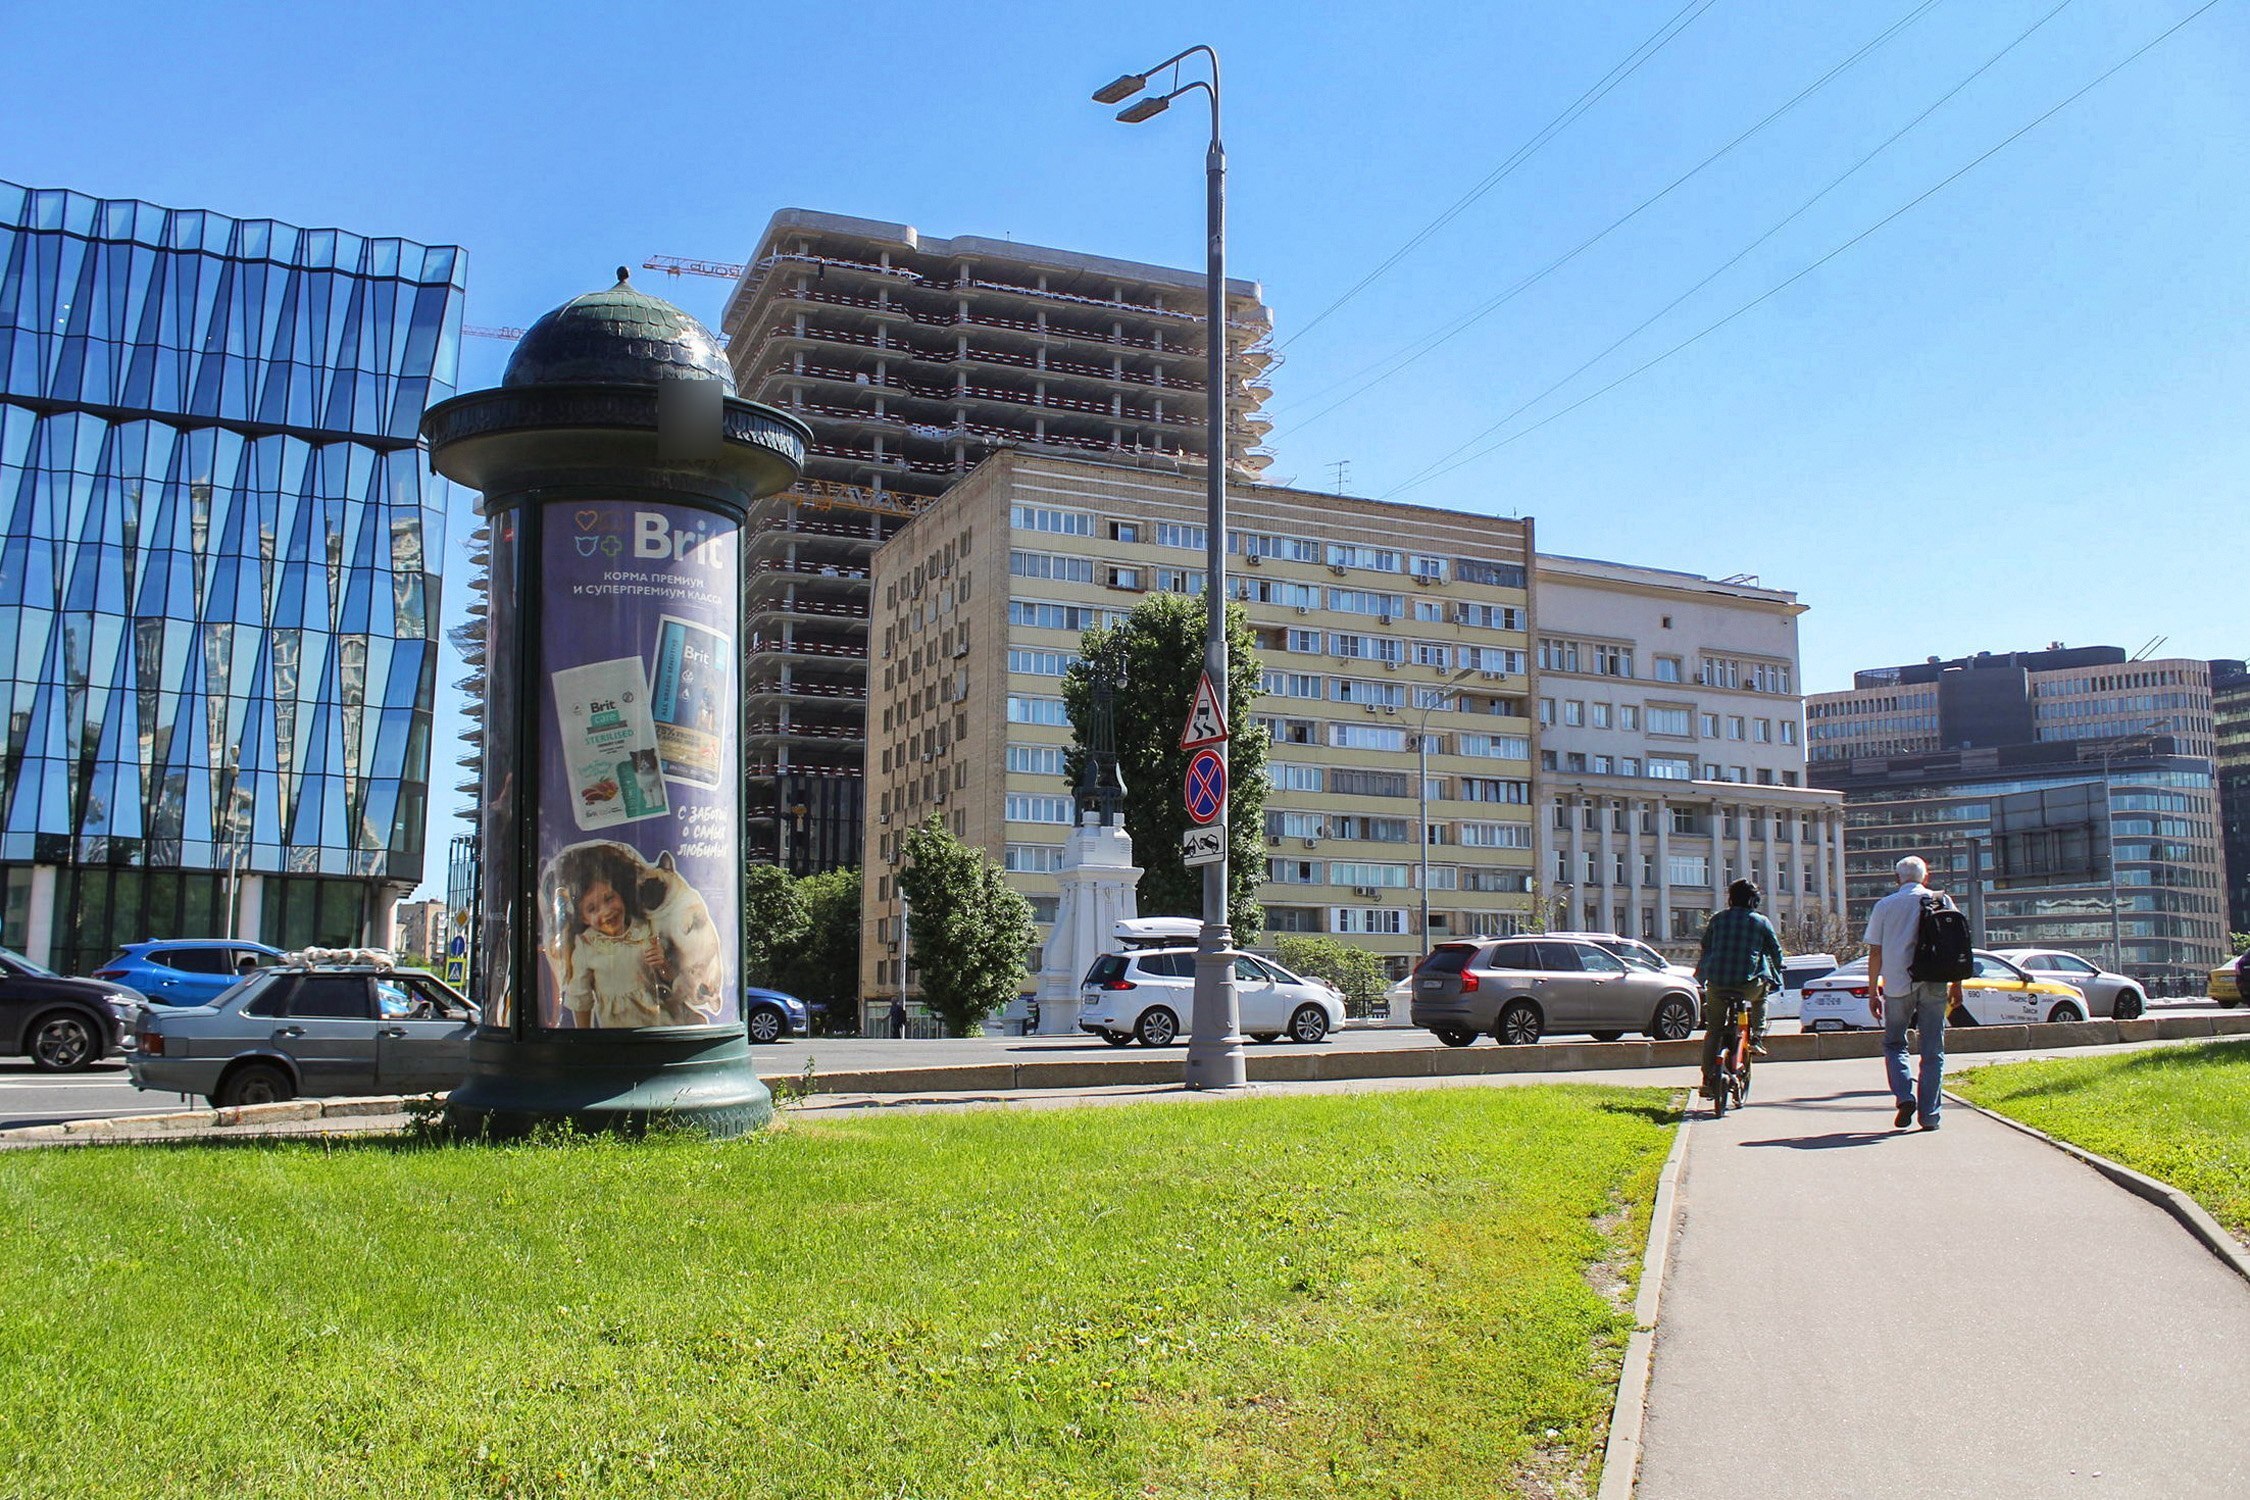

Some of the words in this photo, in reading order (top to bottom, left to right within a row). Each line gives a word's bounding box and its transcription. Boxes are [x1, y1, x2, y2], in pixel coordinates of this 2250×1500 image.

[634, 511, 724, 569] Brit
[604, 571, 648, 582] КОРМА
[651, 573, 704, 588] ПРЕМИУМ
[573, 585, 583, 594] И
[585, 585, 686, 599] СУПЕРПРЕМИУМ
[687, 590, 723, 604] КЛАССА
[683, 645, 710, 665] Brit
[590, 700, 616, 714] Brit
[677, 805, 688, 820] С
